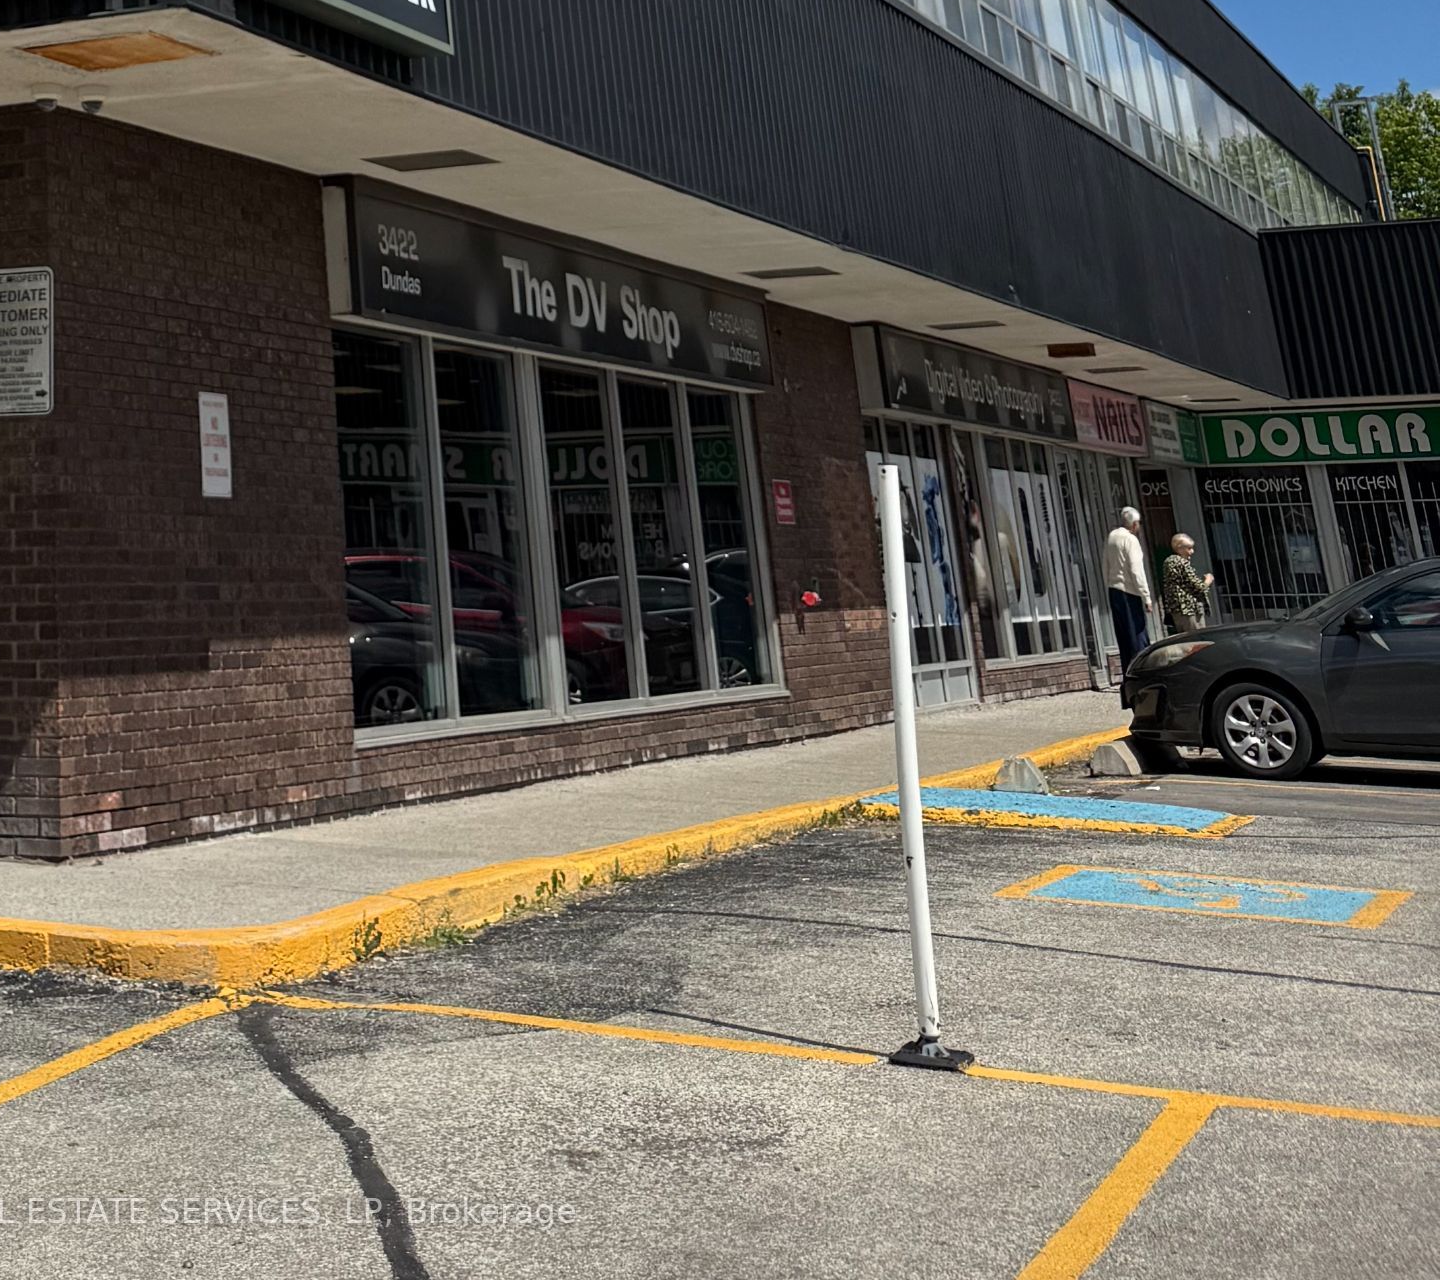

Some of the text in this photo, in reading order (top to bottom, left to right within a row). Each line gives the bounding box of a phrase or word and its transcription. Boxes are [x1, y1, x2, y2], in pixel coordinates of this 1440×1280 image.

[377, 223, 420, 262] 3422
[381, 266, 422, 296] Dundas
[502, 255, 681, 359] The DV Shop
[20, 324, 48, 337] ONLY
[924, 358, 957, 405] Digital
[1092, 394, 1143, 446] NAILS
[1221, 412, 1432, 458] DOLLAR
[1204, 477, 1303, 494] ELECTRONICS
[1335, 475, 1398, 491] KITCHEN
